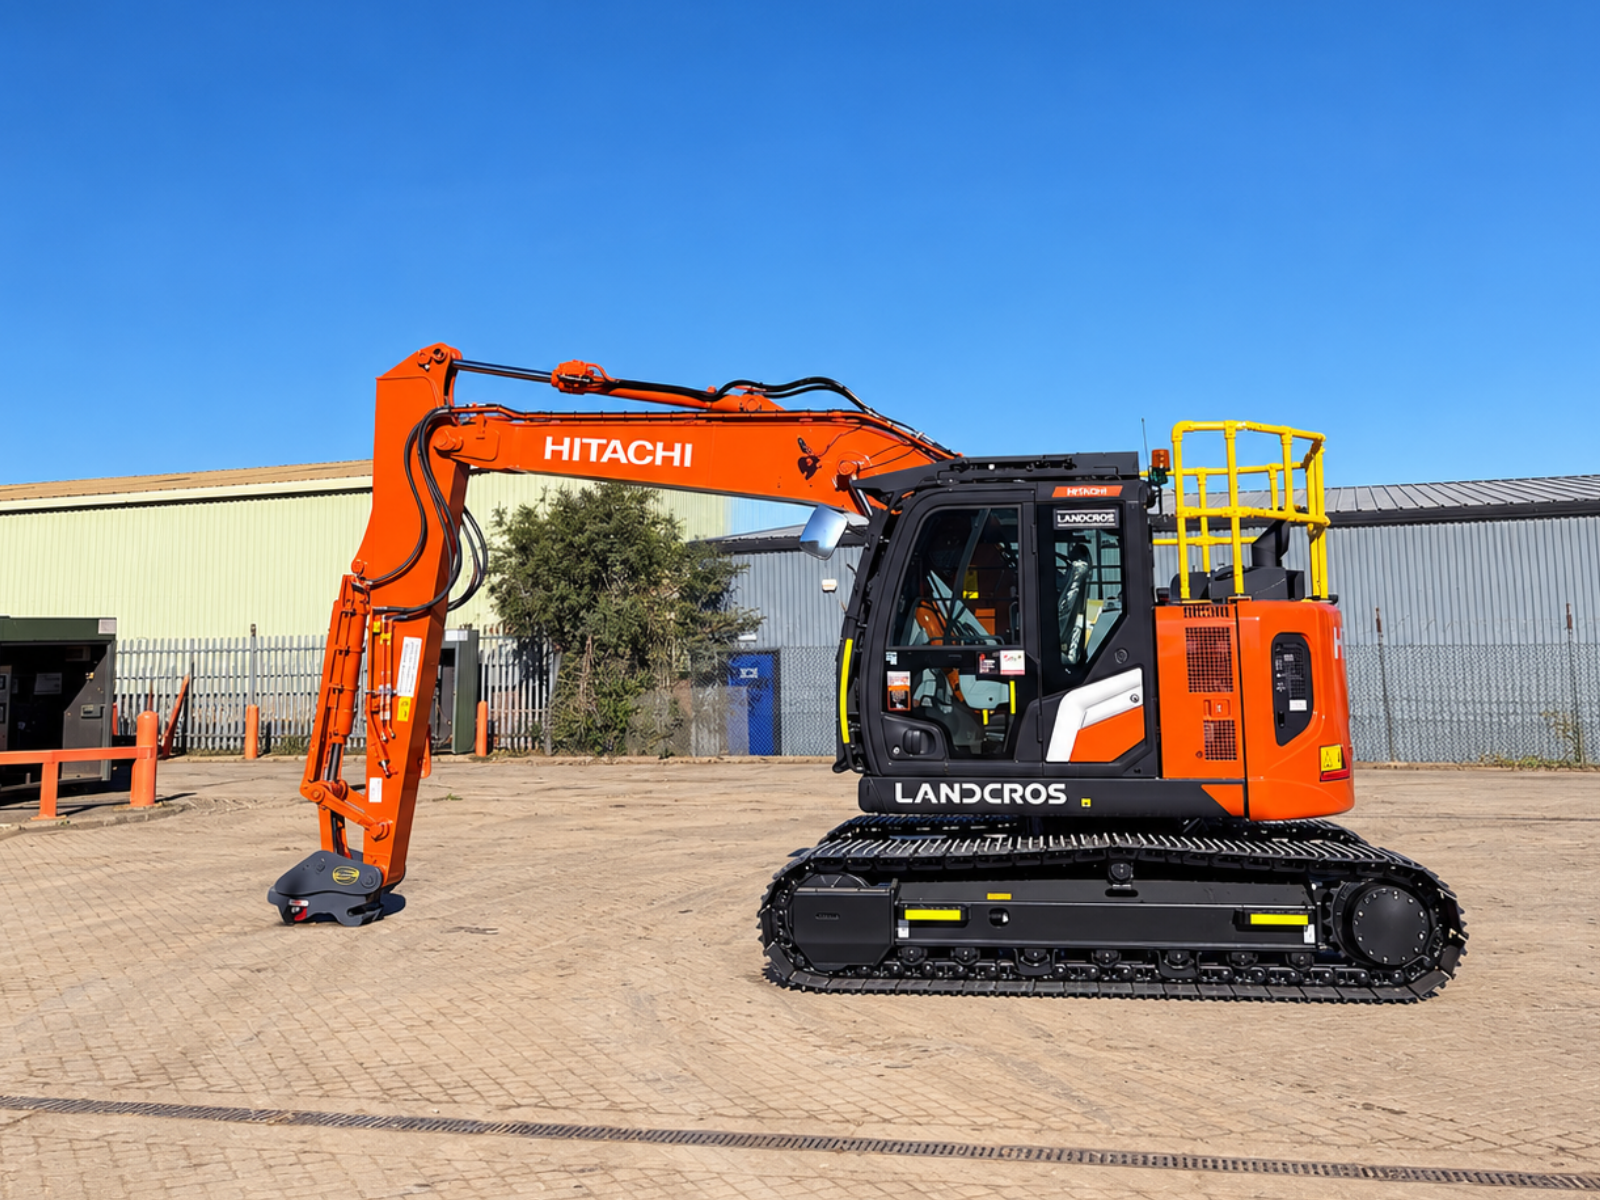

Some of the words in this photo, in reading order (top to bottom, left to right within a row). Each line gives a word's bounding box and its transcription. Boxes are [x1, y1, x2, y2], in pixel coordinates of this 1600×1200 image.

[544, 436, 693, 468] HITACHI
[1057, 513, 1115, 523] LANDCROS
[895, 782, 1068, 805] LANDCROS
